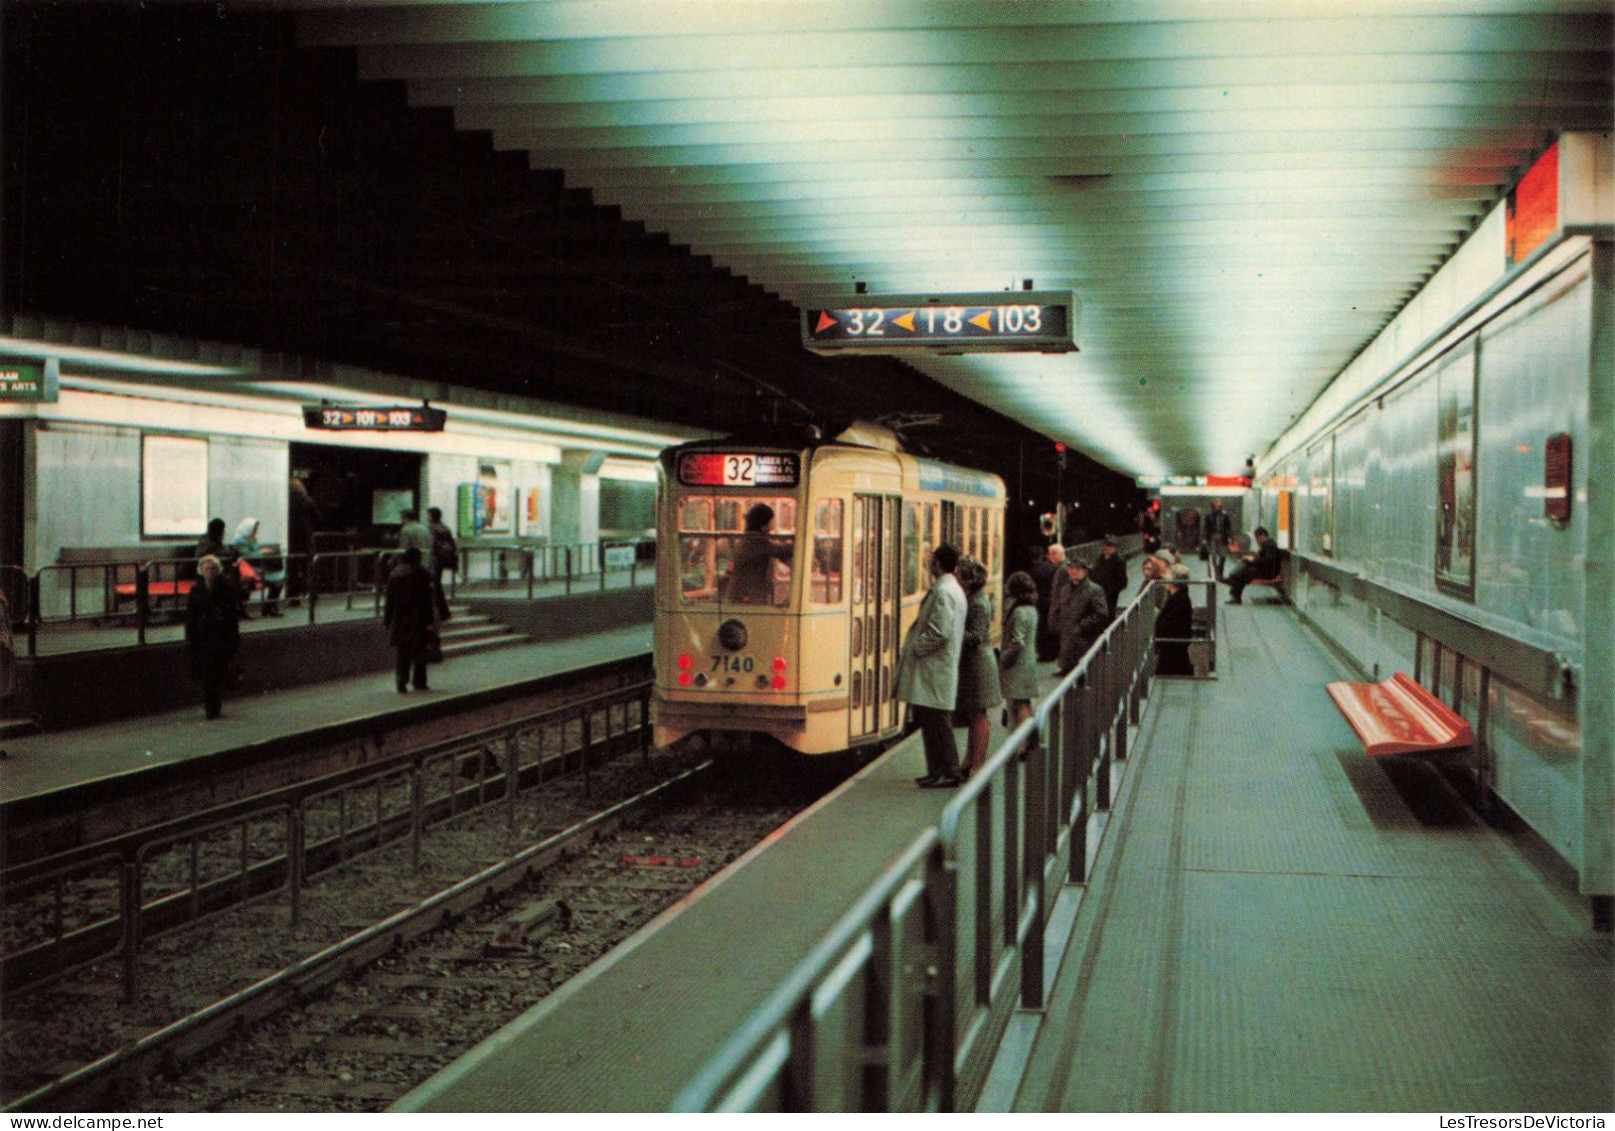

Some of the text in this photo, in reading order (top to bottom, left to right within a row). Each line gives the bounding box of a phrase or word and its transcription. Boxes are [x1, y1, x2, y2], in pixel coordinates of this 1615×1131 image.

[846, 308, 885, 335] 32
[997, 305, 1042, 333] 103
[322, 410, 411, 426] 32 101 103
[727, 456, 754, 481] 32
[711, 655, 755, 673] 7140
